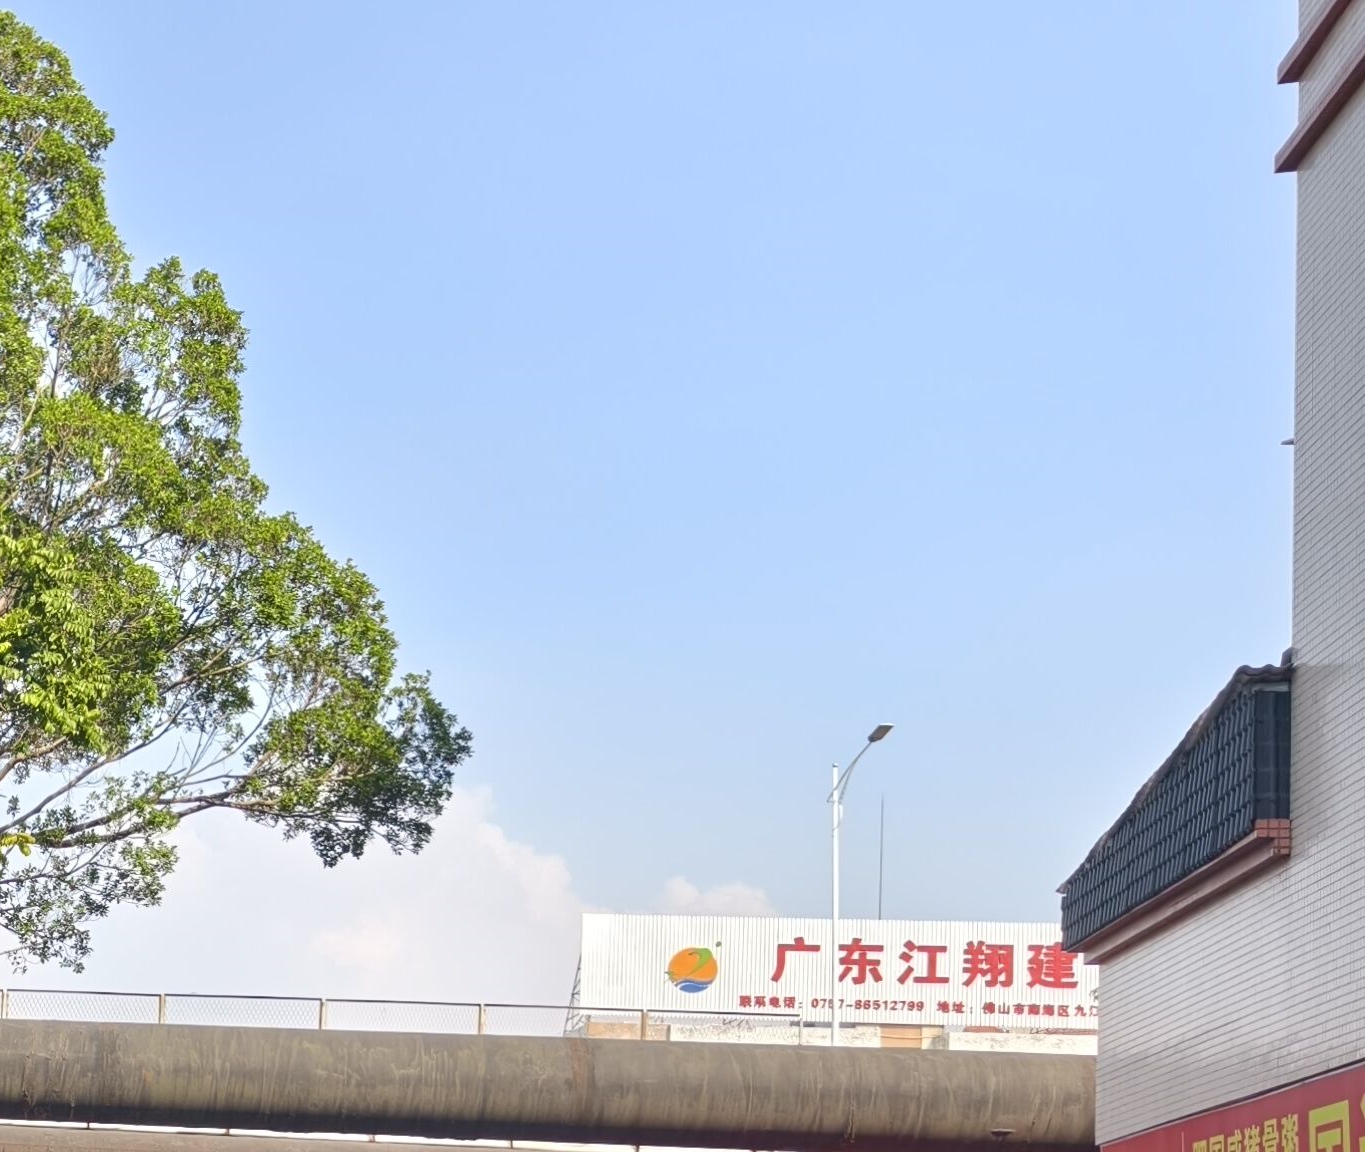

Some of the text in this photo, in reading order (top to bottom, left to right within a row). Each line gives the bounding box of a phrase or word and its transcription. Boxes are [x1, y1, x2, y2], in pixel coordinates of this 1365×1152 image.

[771, 936, 1079, 989] 广东江翔建
